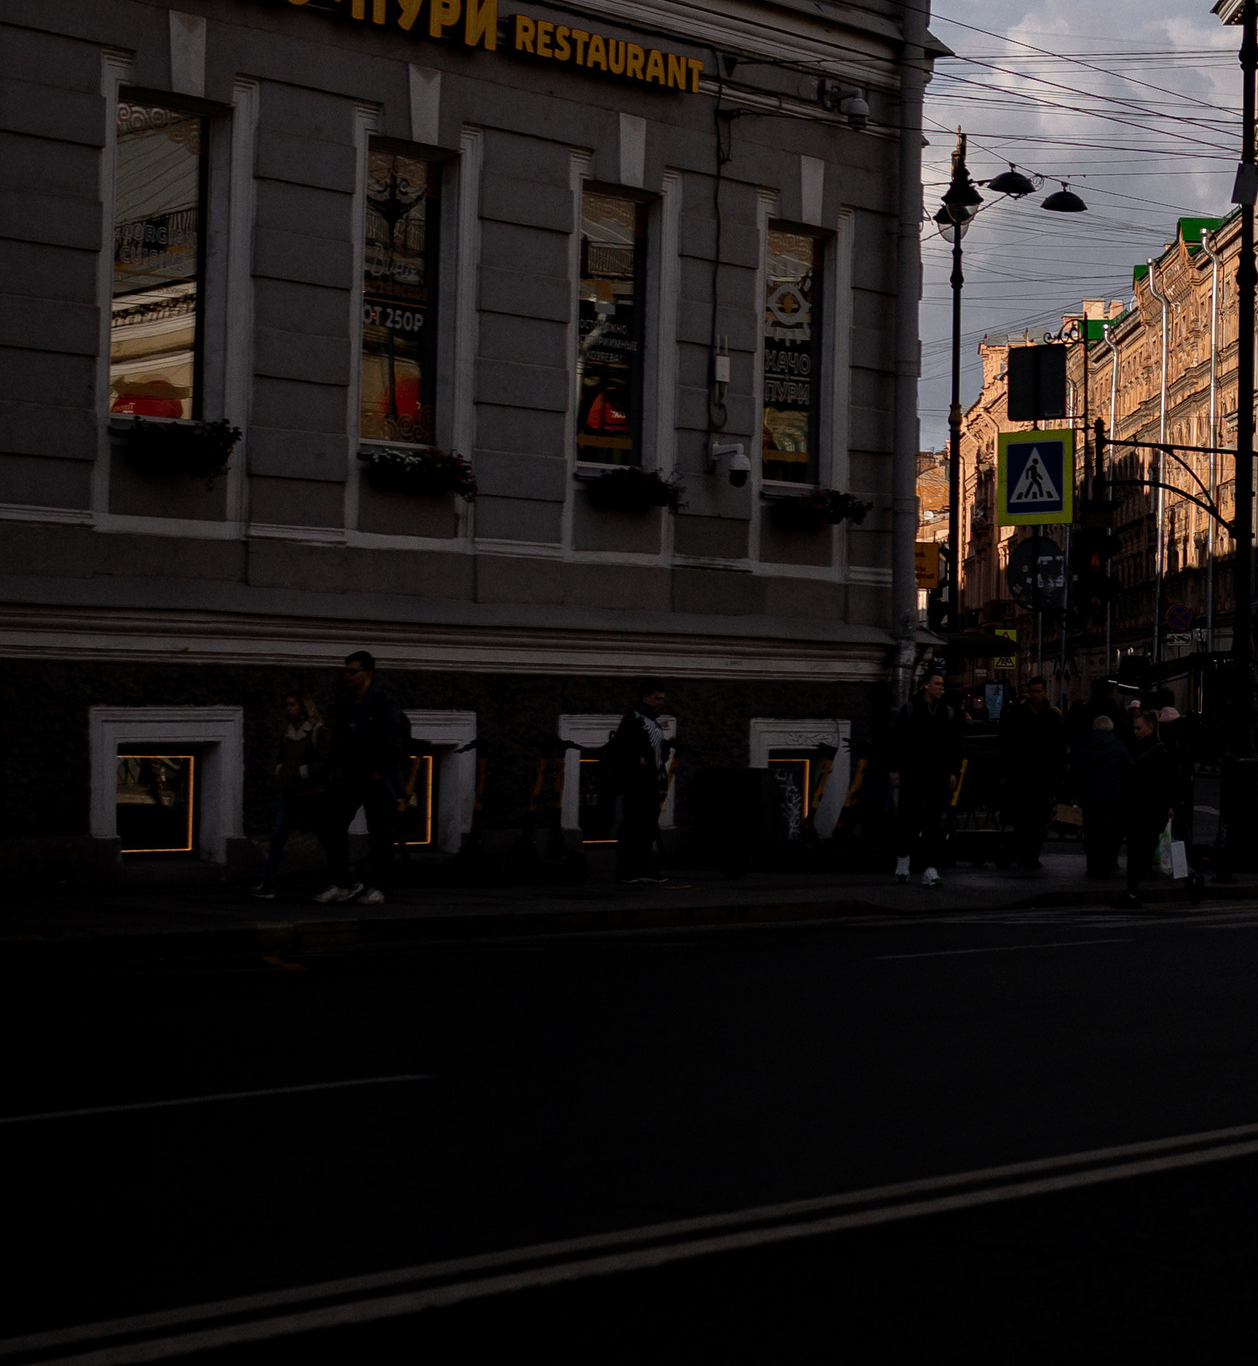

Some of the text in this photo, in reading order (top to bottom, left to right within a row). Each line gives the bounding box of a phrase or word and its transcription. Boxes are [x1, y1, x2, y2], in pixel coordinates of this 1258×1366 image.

[512, 14, 704, 93] RESTAURANT
[765, 348, 812, 375] ХАЧО
[765, 380, 810, 406] ПУРИ
